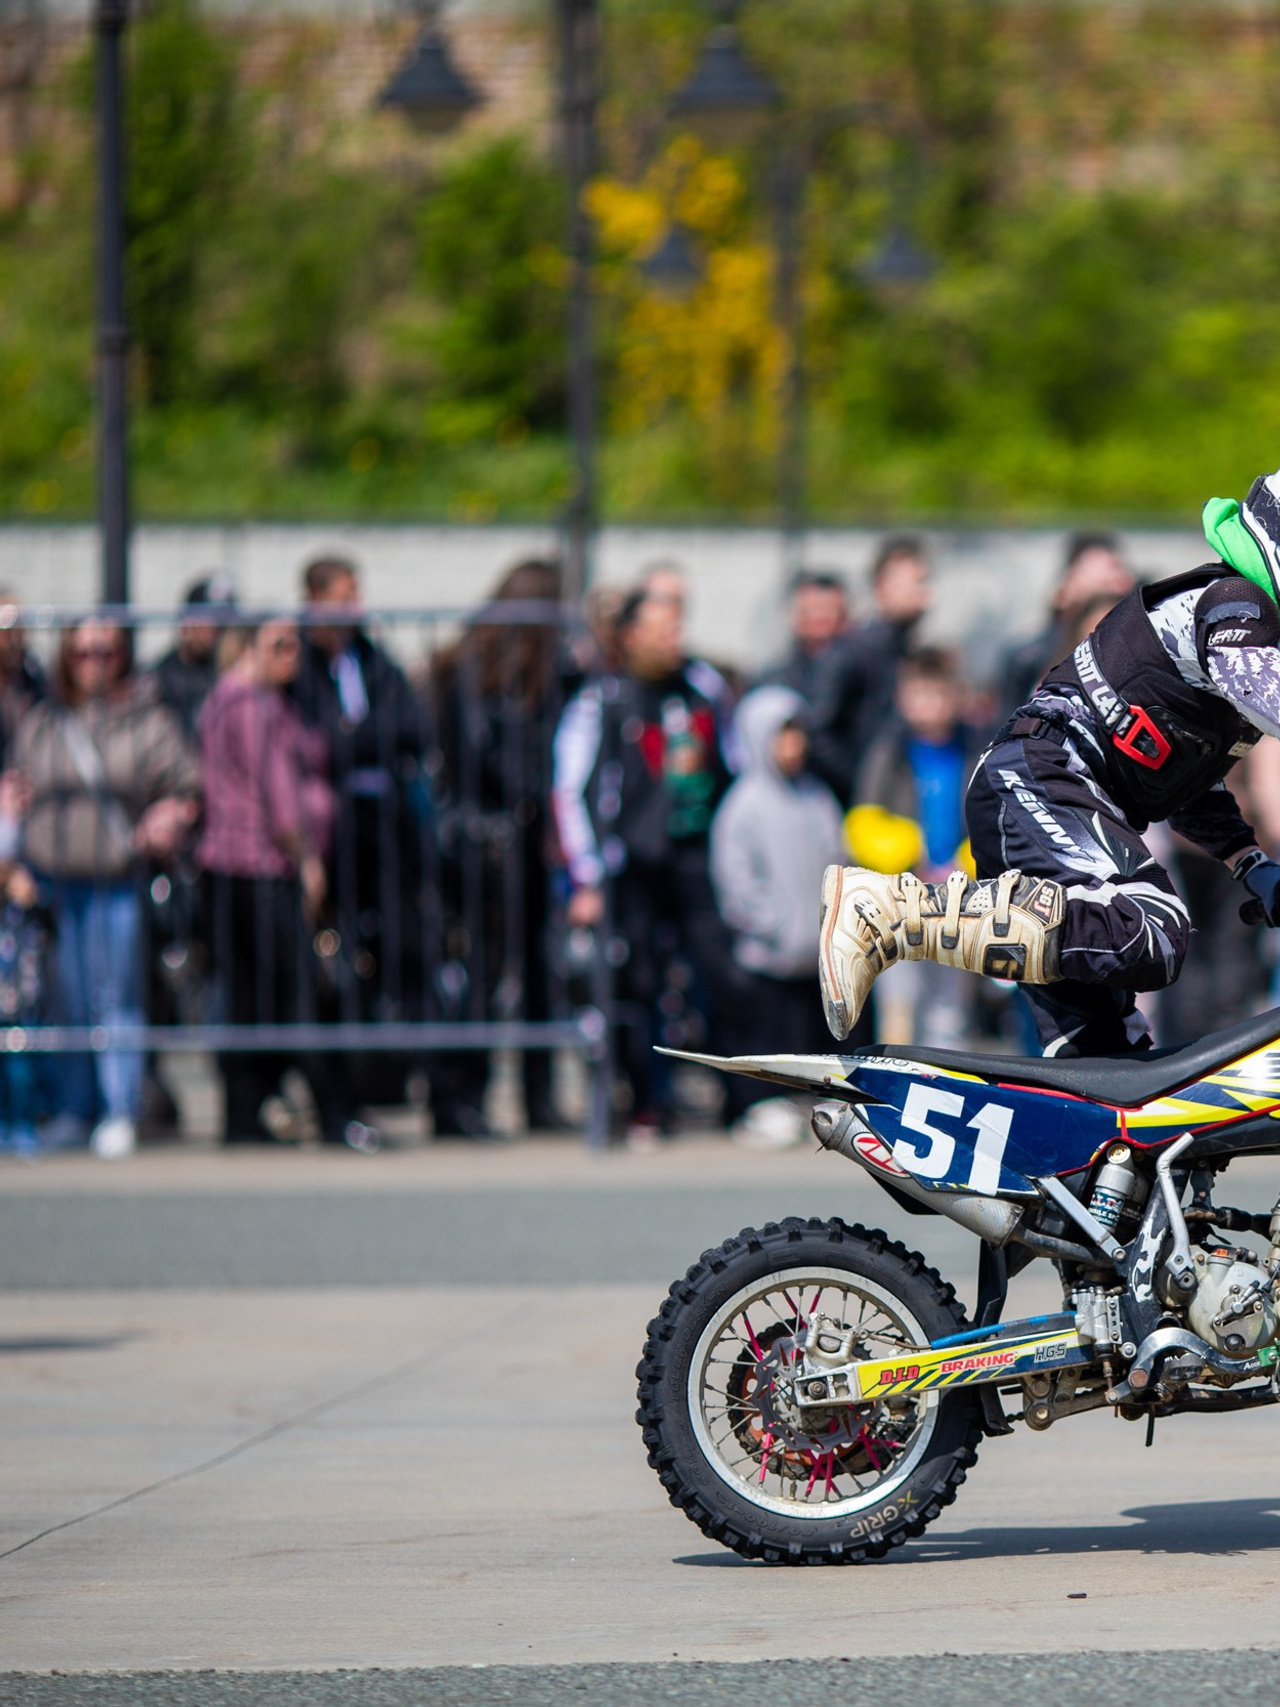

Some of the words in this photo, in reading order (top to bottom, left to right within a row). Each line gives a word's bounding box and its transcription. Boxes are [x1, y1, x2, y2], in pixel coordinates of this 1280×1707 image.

[1208, 628, 1251, 646] LEATT
[1073, 641, 1104, 687] EATT
[892, 1082, 1014, 1197] 51
[940, 1352, 1015, 1374] BRAKING
[1033, 1342, 1067, 1363] HGS
[879, 1365, 921, 1385] D.I.D
[850, 1490, 919, 1538] X-GRIP
